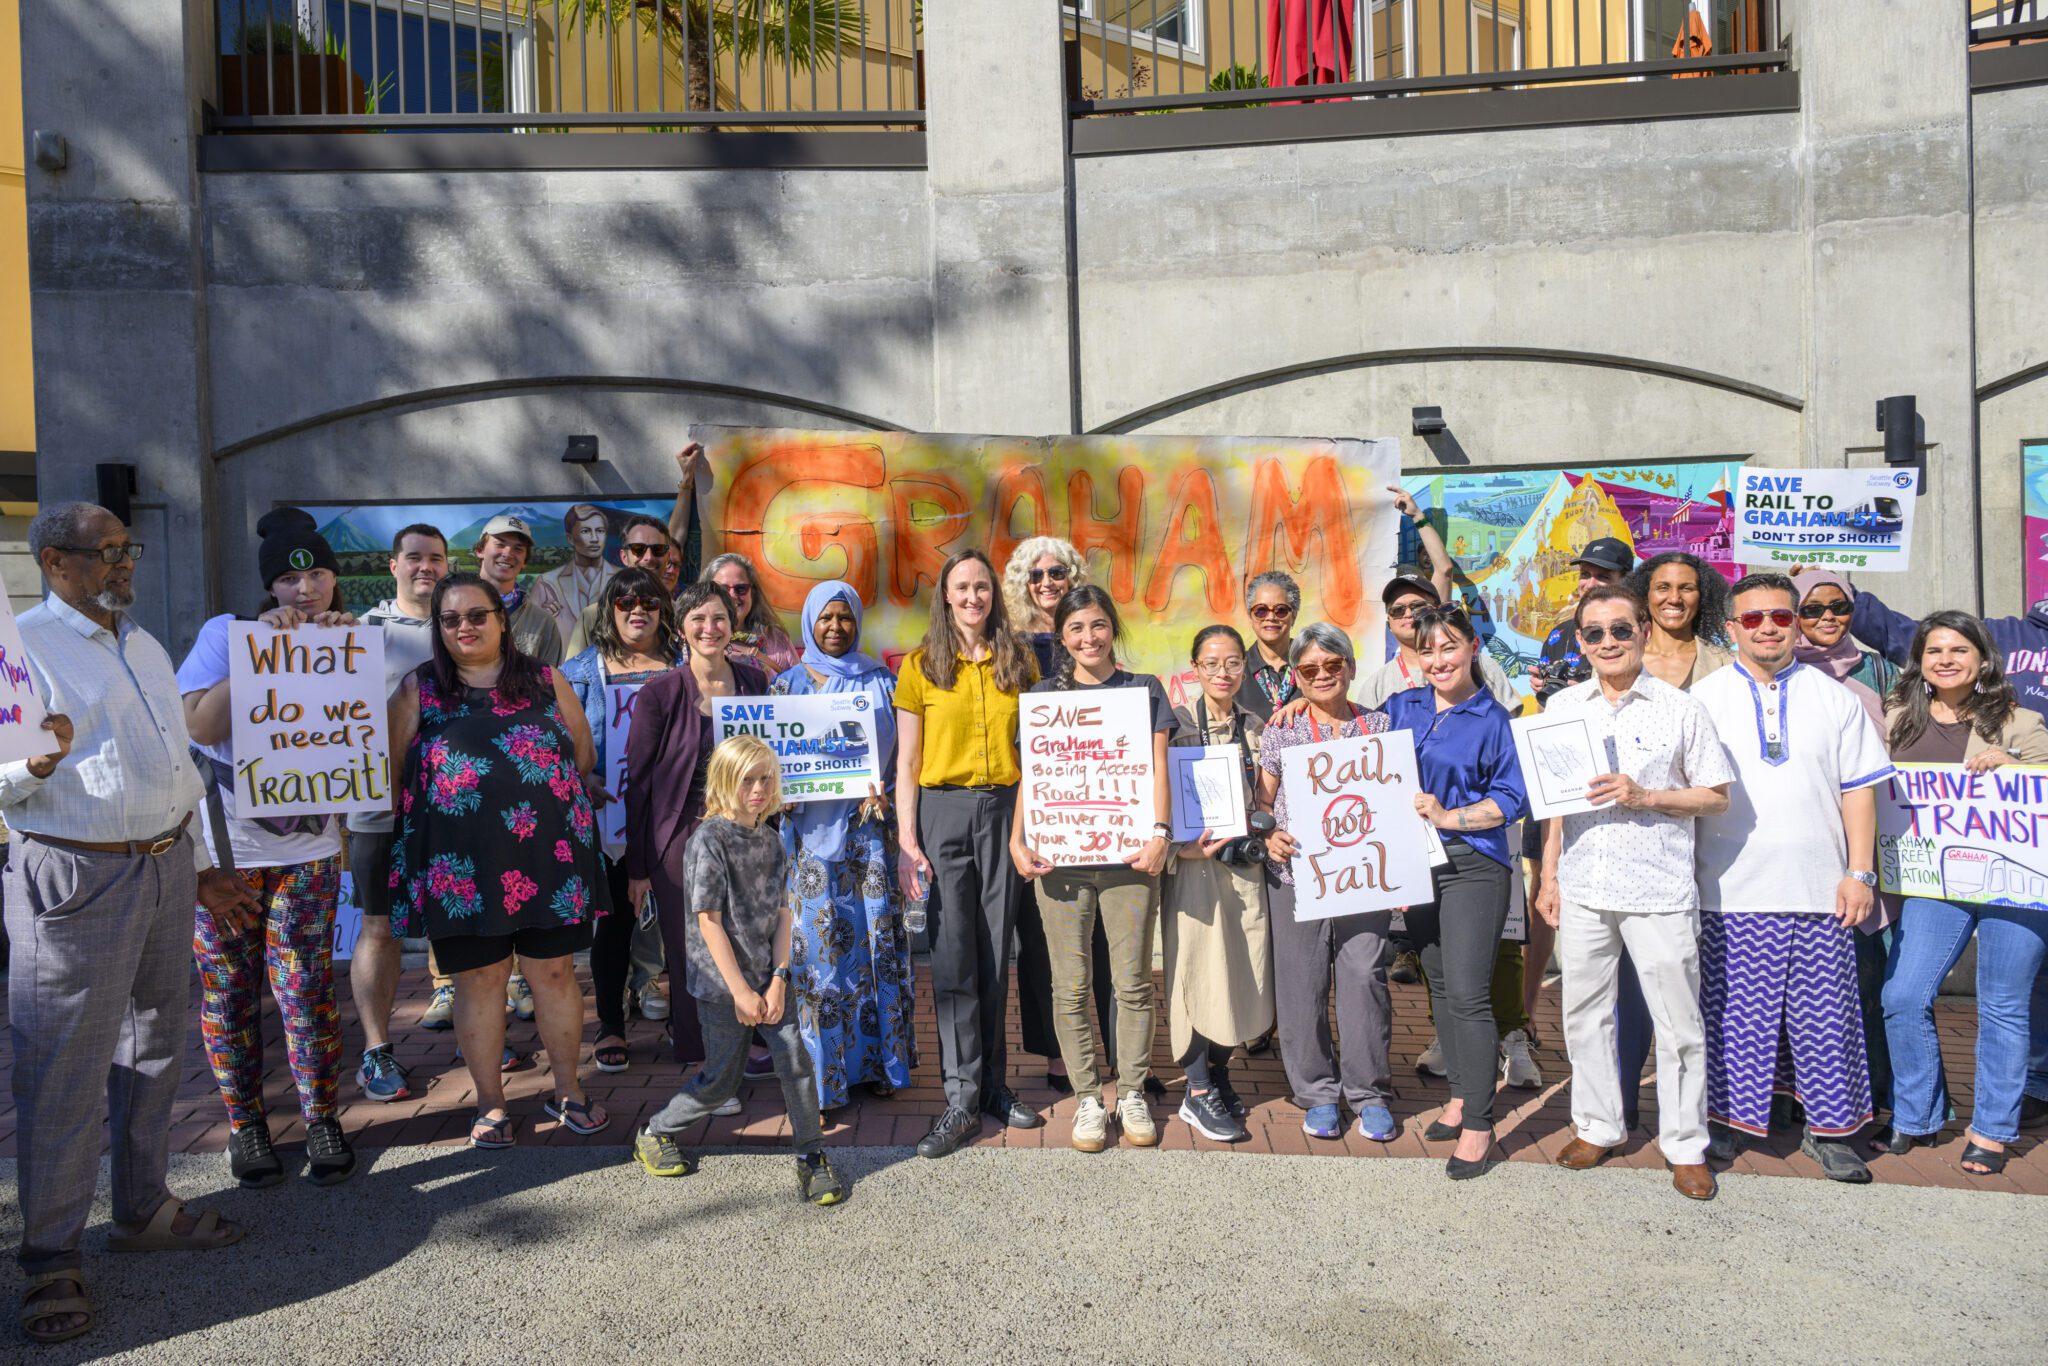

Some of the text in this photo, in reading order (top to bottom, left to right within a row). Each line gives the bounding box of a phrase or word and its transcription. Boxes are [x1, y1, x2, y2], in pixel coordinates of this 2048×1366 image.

[1746, 475, 1803, 493] SAVE
[1745, 494, 1834, 510] RAIL TO
[1744, 510, 1881, 527] GRAHAM ST
[723, 443, 1363, 628] GRAHAM
[1752, 531, 1892, 544] DON'T STOP SHORT!
[1771, 550, 1867, 567] SaveST3.org
[247, 631, 367, 675] What
[2005, 646, 2048, 675] LON
[250, 688, 373, 724] do we
[721, 704, 775, 721] SAVE
[1029, 704, 1103, 728] SAVE
[269, 725, 376, 751] need?
[723, 722, 805, 739] RAIL TO
[769, 737, 849, 757] HAM ST
[1055, 749, 1131, 762] STREET
[815, 758, 862, 771] SHORT!
[1307, 737, 1402, 795] Rail,
[1031, 760, 1149, 788] Boeing Access
[782, 781, 845, 796] eST3.org
[1888, 769, 1986, 801] THRIVE
[1030, 809, 1134, 827] Deliver on
[1322, 801, 1378, 838] not
[1879, 833, 1936, 850] GRAHAM
[1883, 849, 1934, 866] STREET
[1948, 849, 1989, 862] GRAHAM
[1308, 840, 1402, 900] Fail
[1882, 865, 1941, 886] STATION
